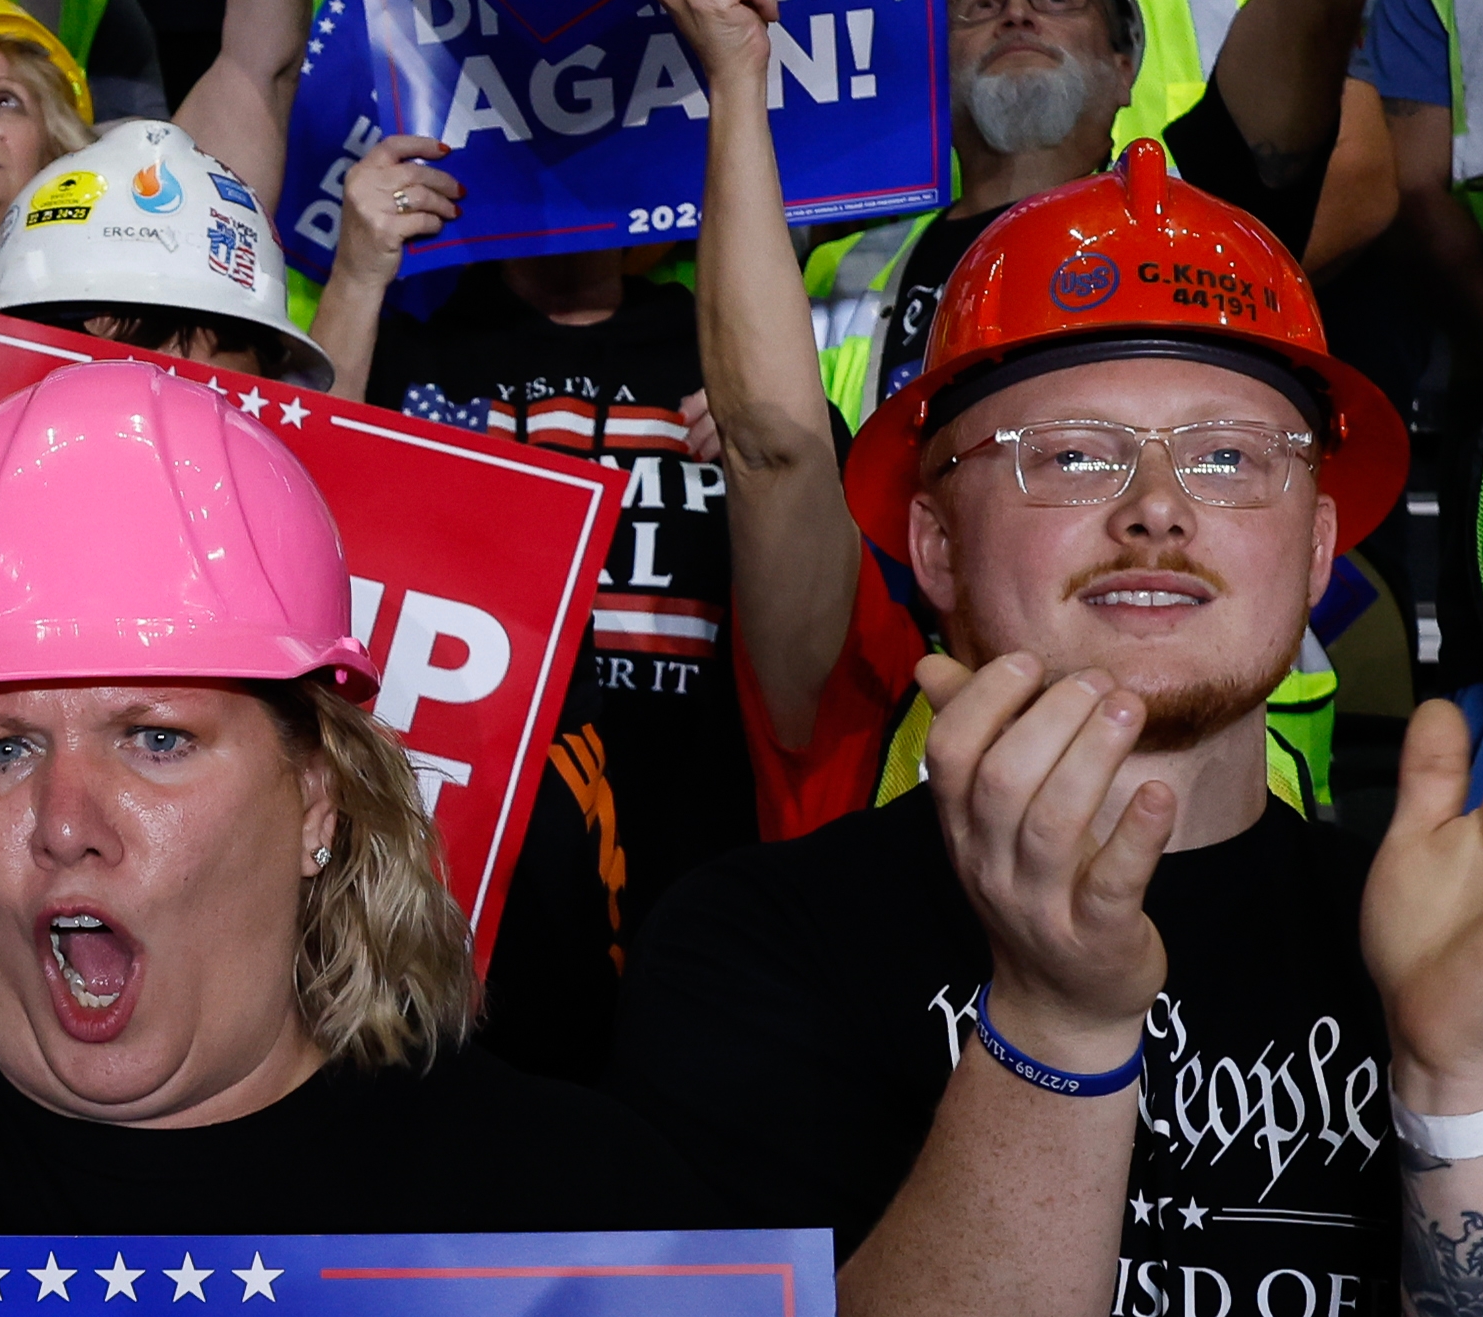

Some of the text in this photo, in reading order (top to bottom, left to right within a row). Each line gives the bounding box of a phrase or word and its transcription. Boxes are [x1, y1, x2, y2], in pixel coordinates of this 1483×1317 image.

[441, 8, 879, 151] AGAN!
[1059, 265, 1110, 297] USS
[1173, 287, 1258, 322] 44191
[1015, 1060, 1080, 1093] 6/27/89
